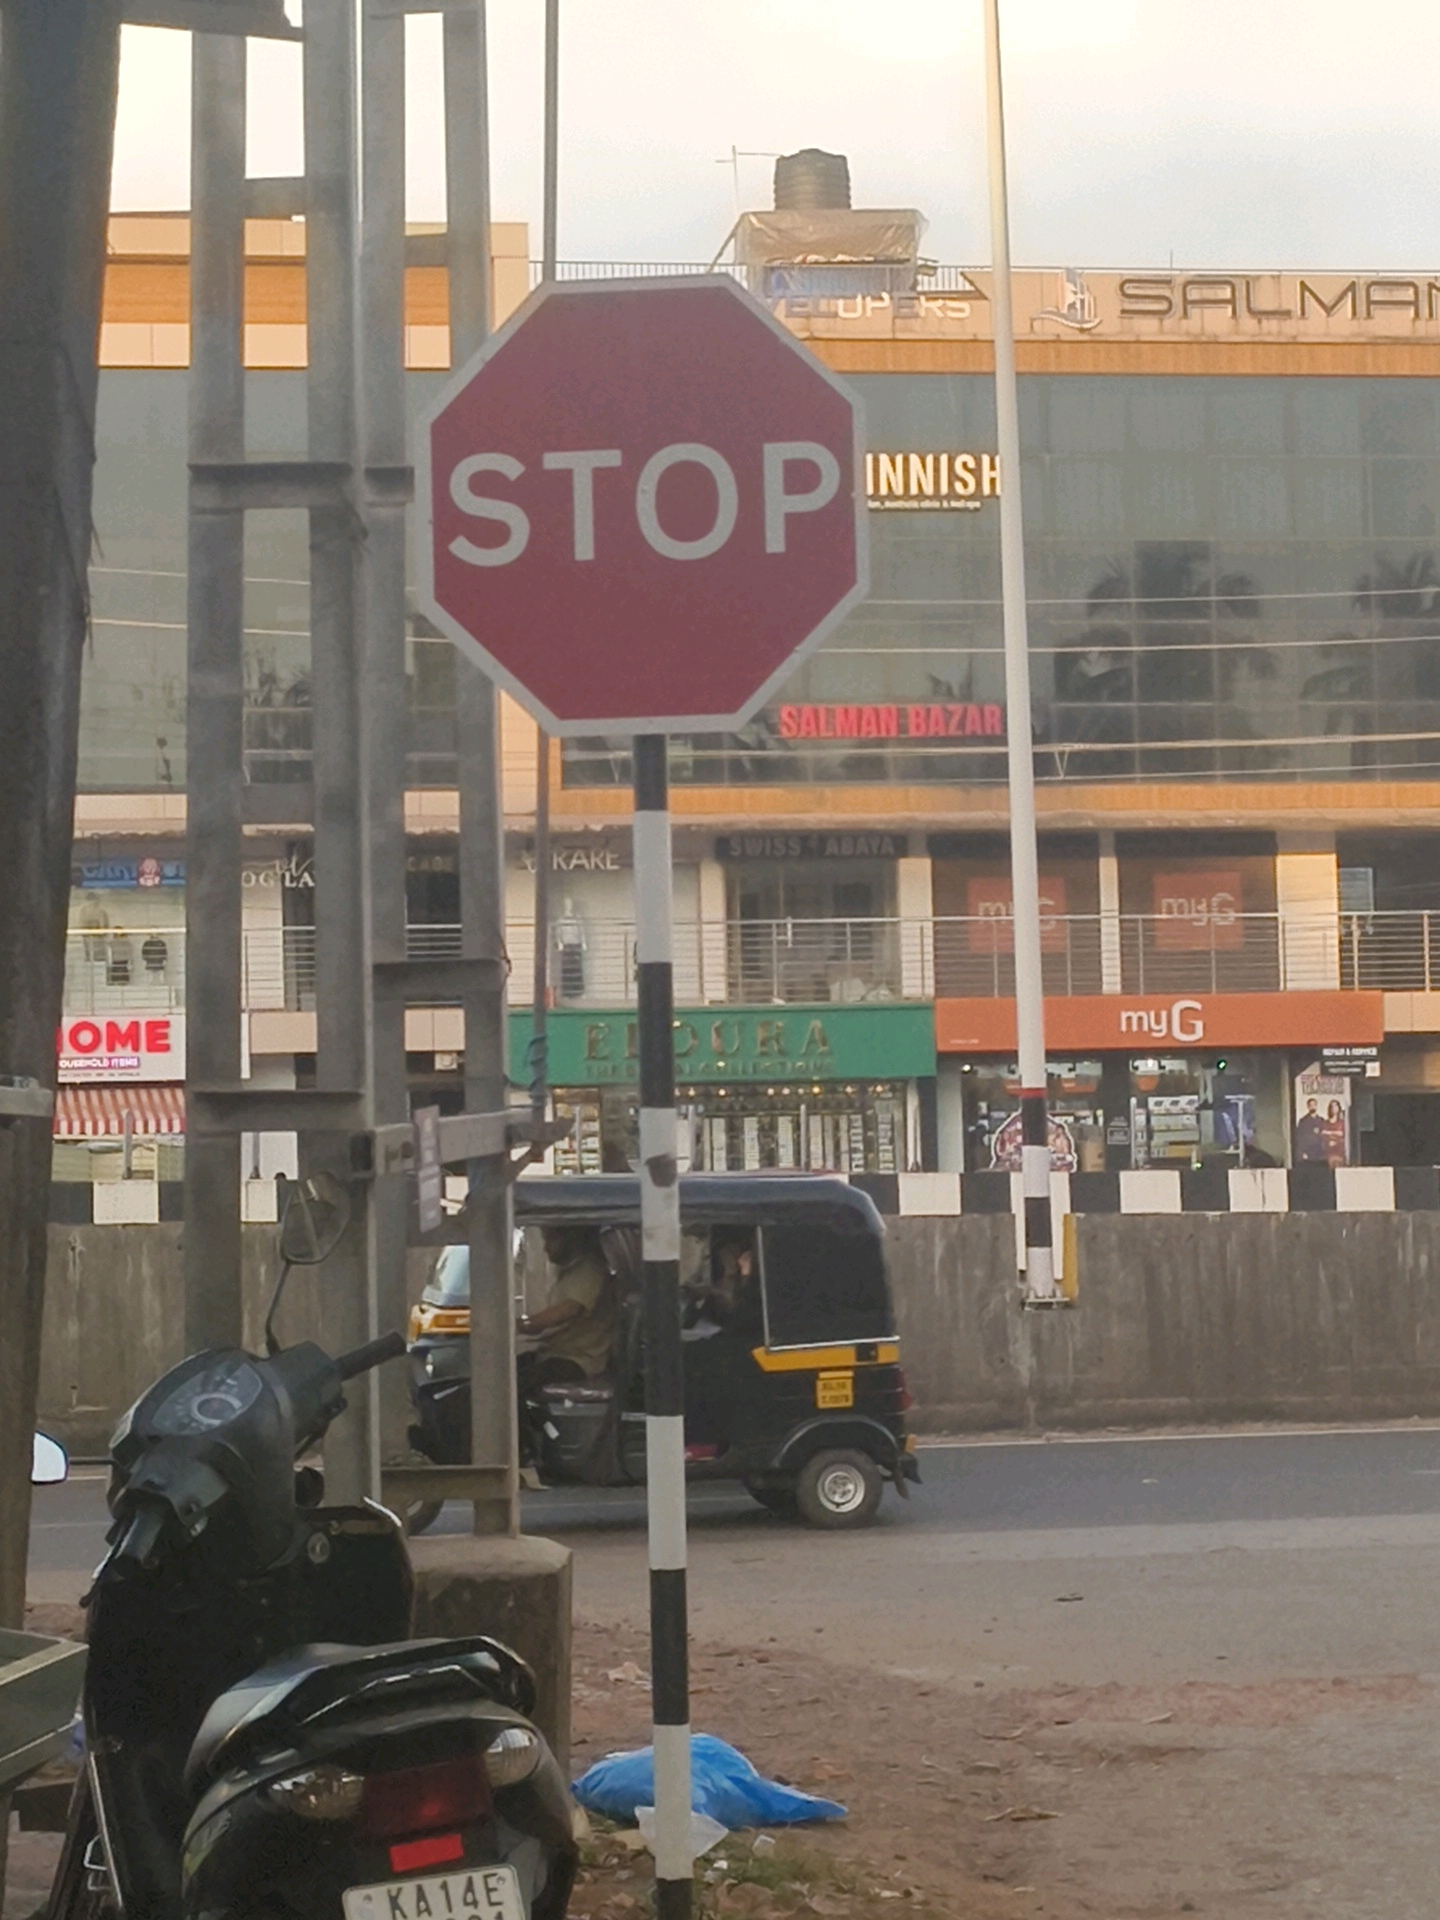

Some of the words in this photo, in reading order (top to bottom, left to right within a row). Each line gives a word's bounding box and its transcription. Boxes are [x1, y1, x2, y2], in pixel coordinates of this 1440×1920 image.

[1119, 279, 1440, 319] SALMA
[448, 441, 841, 567] STOP
[779, 705, 898, 738] SALMAN
[907, 704, 1003, 737] BAZAR
[728, 836, 801, 858] SWISS
[825, 834, 895, 857] ABAYA
[1119, 999, 1204, 1043] myG
[386, 1872, 504, 1920] KA14E
